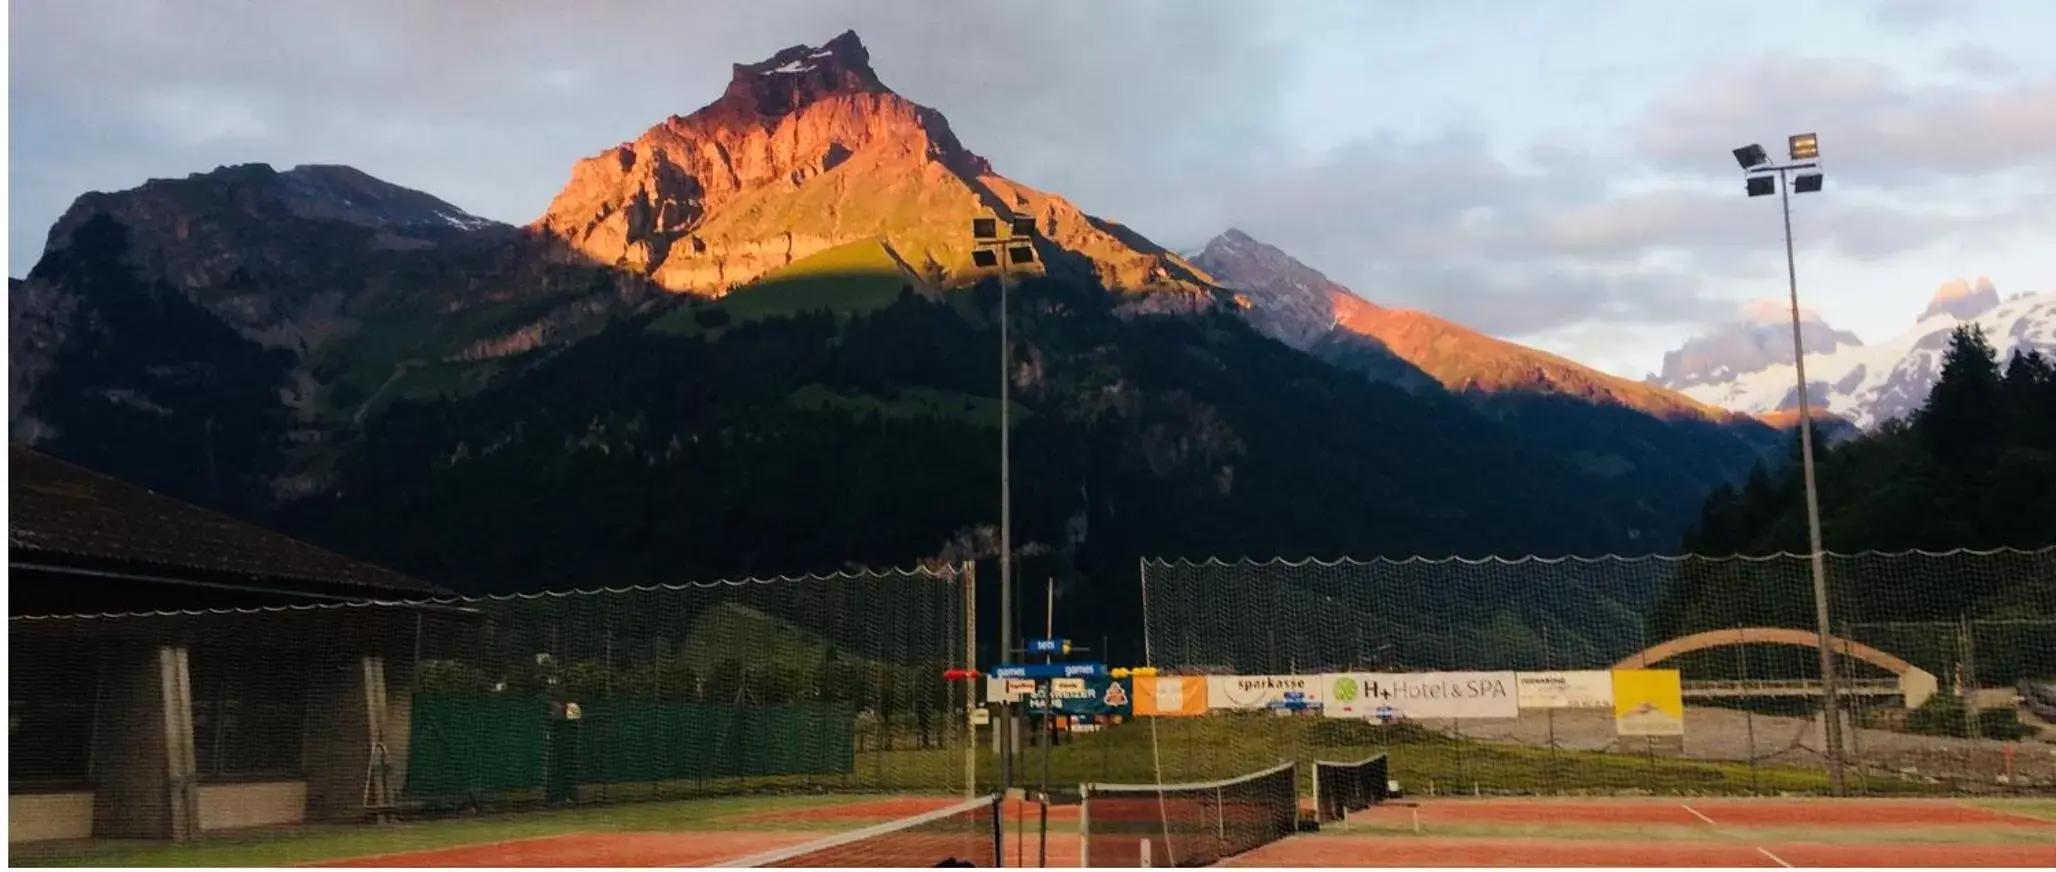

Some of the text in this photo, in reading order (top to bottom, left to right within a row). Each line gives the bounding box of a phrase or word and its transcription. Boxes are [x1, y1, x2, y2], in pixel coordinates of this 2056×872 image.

[996, 667, 1026, 678] games
[1065, 665, 1094, 676] games
[1238, 676, 1305, 691] sparkasse
[1467, 679, 1506, 698] SPA
